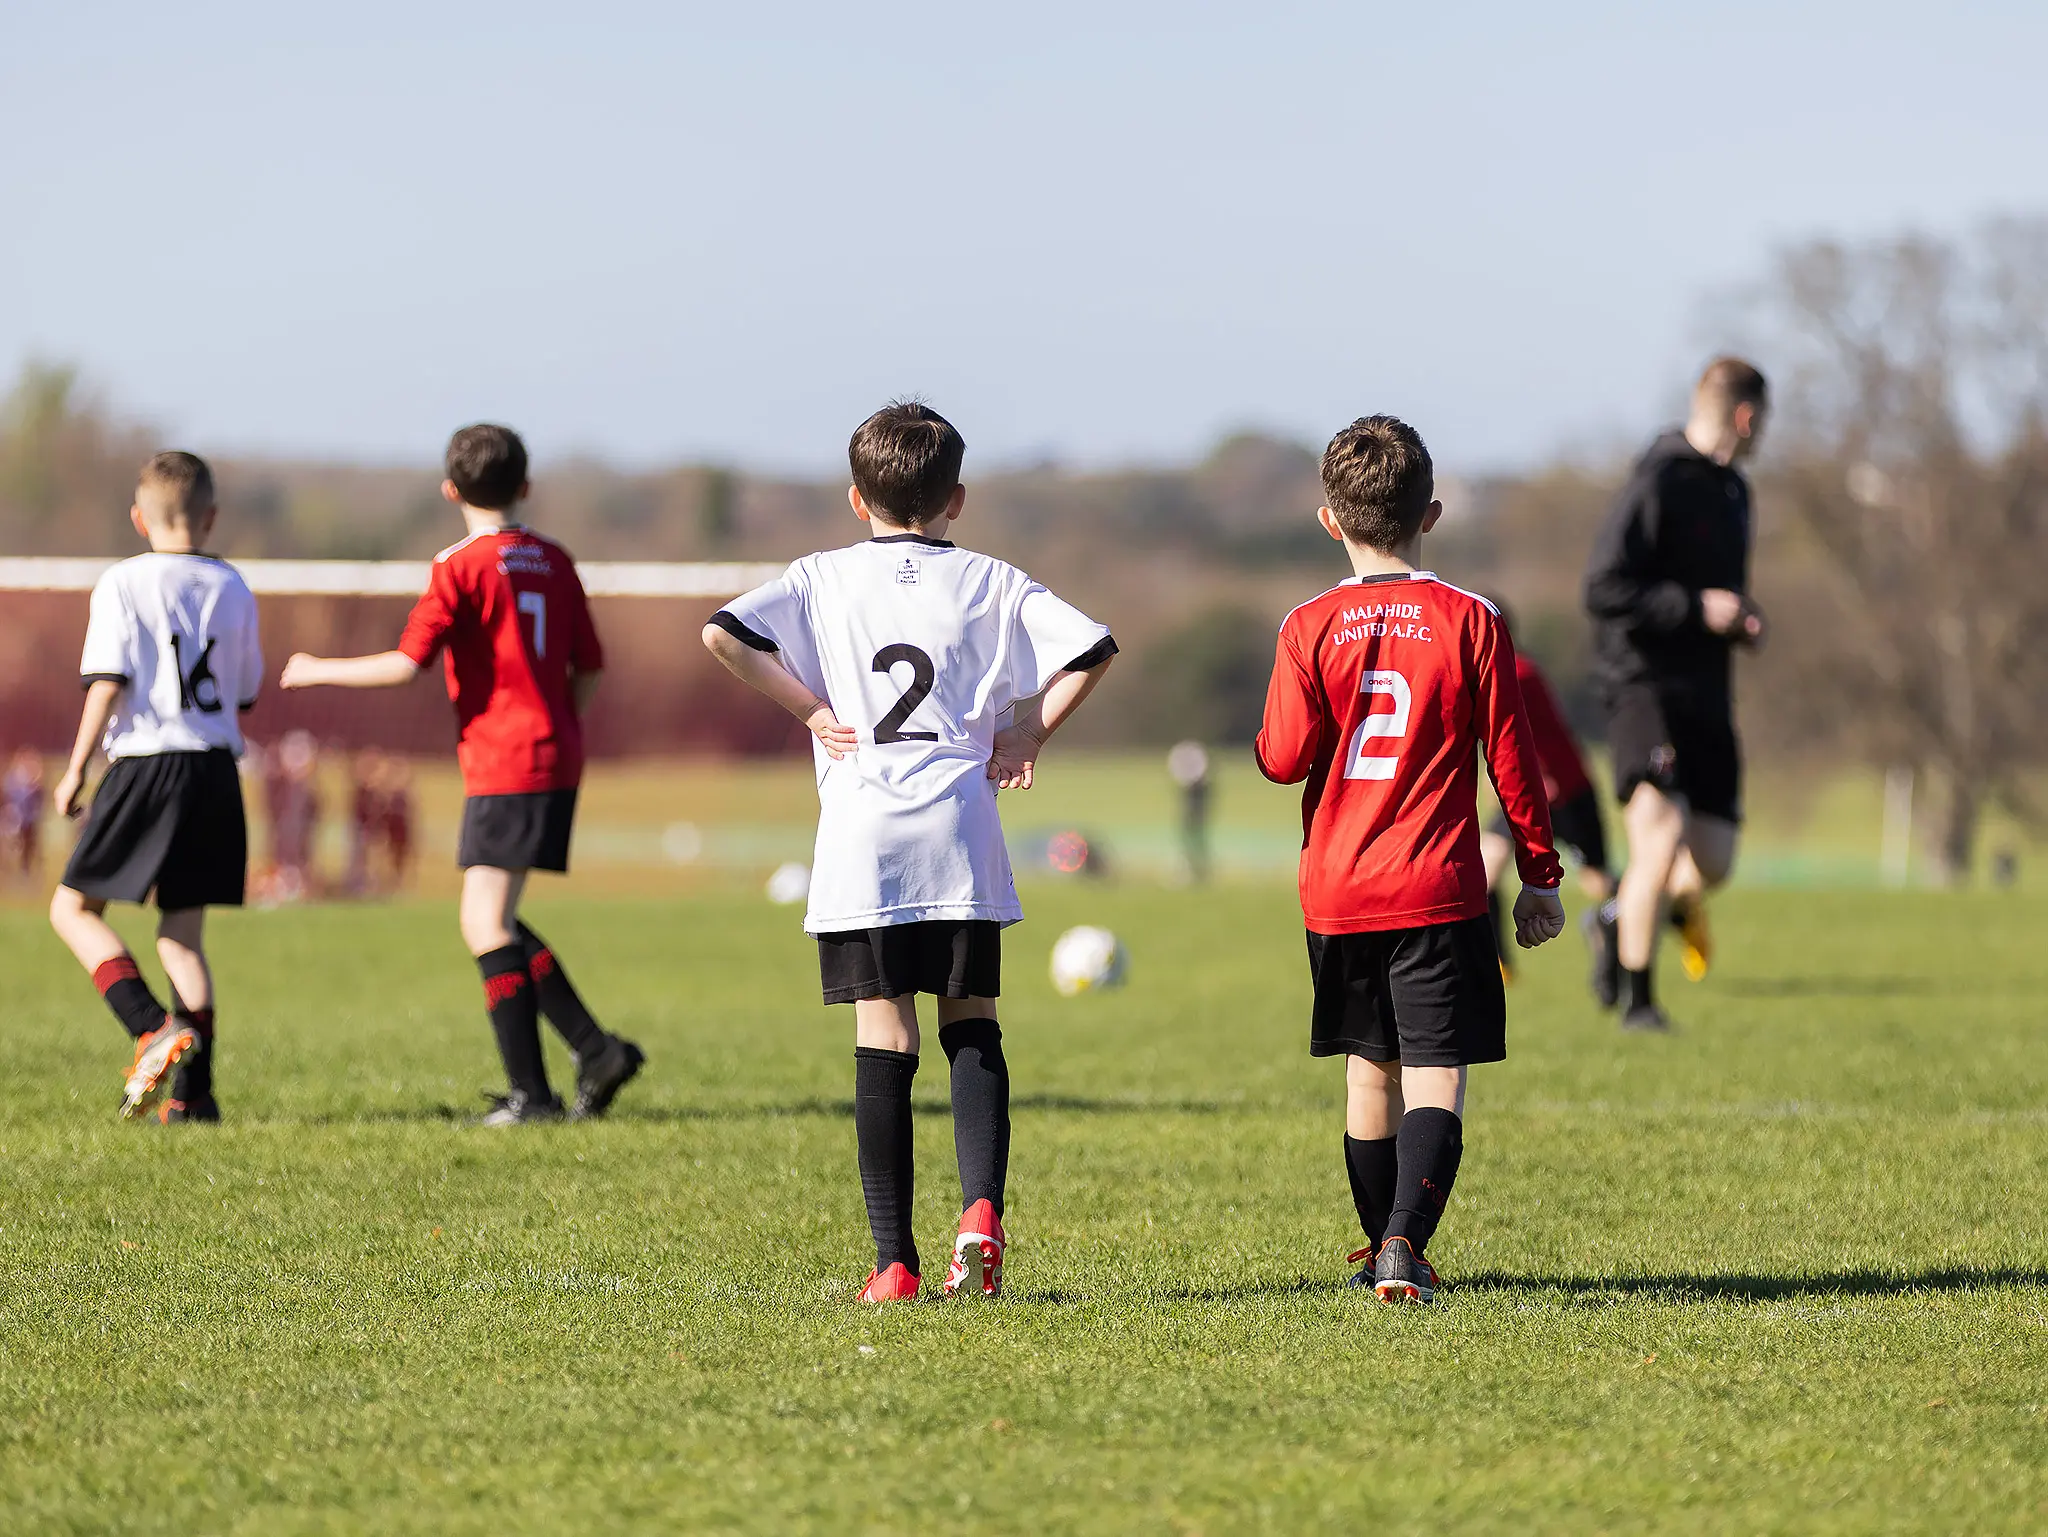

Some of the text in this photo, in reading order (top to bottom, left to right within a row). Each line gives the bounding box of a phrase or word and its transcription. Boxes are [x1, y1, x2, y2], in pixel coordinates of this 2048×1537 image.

[517, 591, 546, 660] 7
[1333, 622, 1432, 646] UNITED A.F.C.
[1342, 603, 1423, 625] MALAHIDE
[170, 633, 222, 713] 16
[872, 643, 939, 745] 2
[1343, 670, 1412, 780] 2
